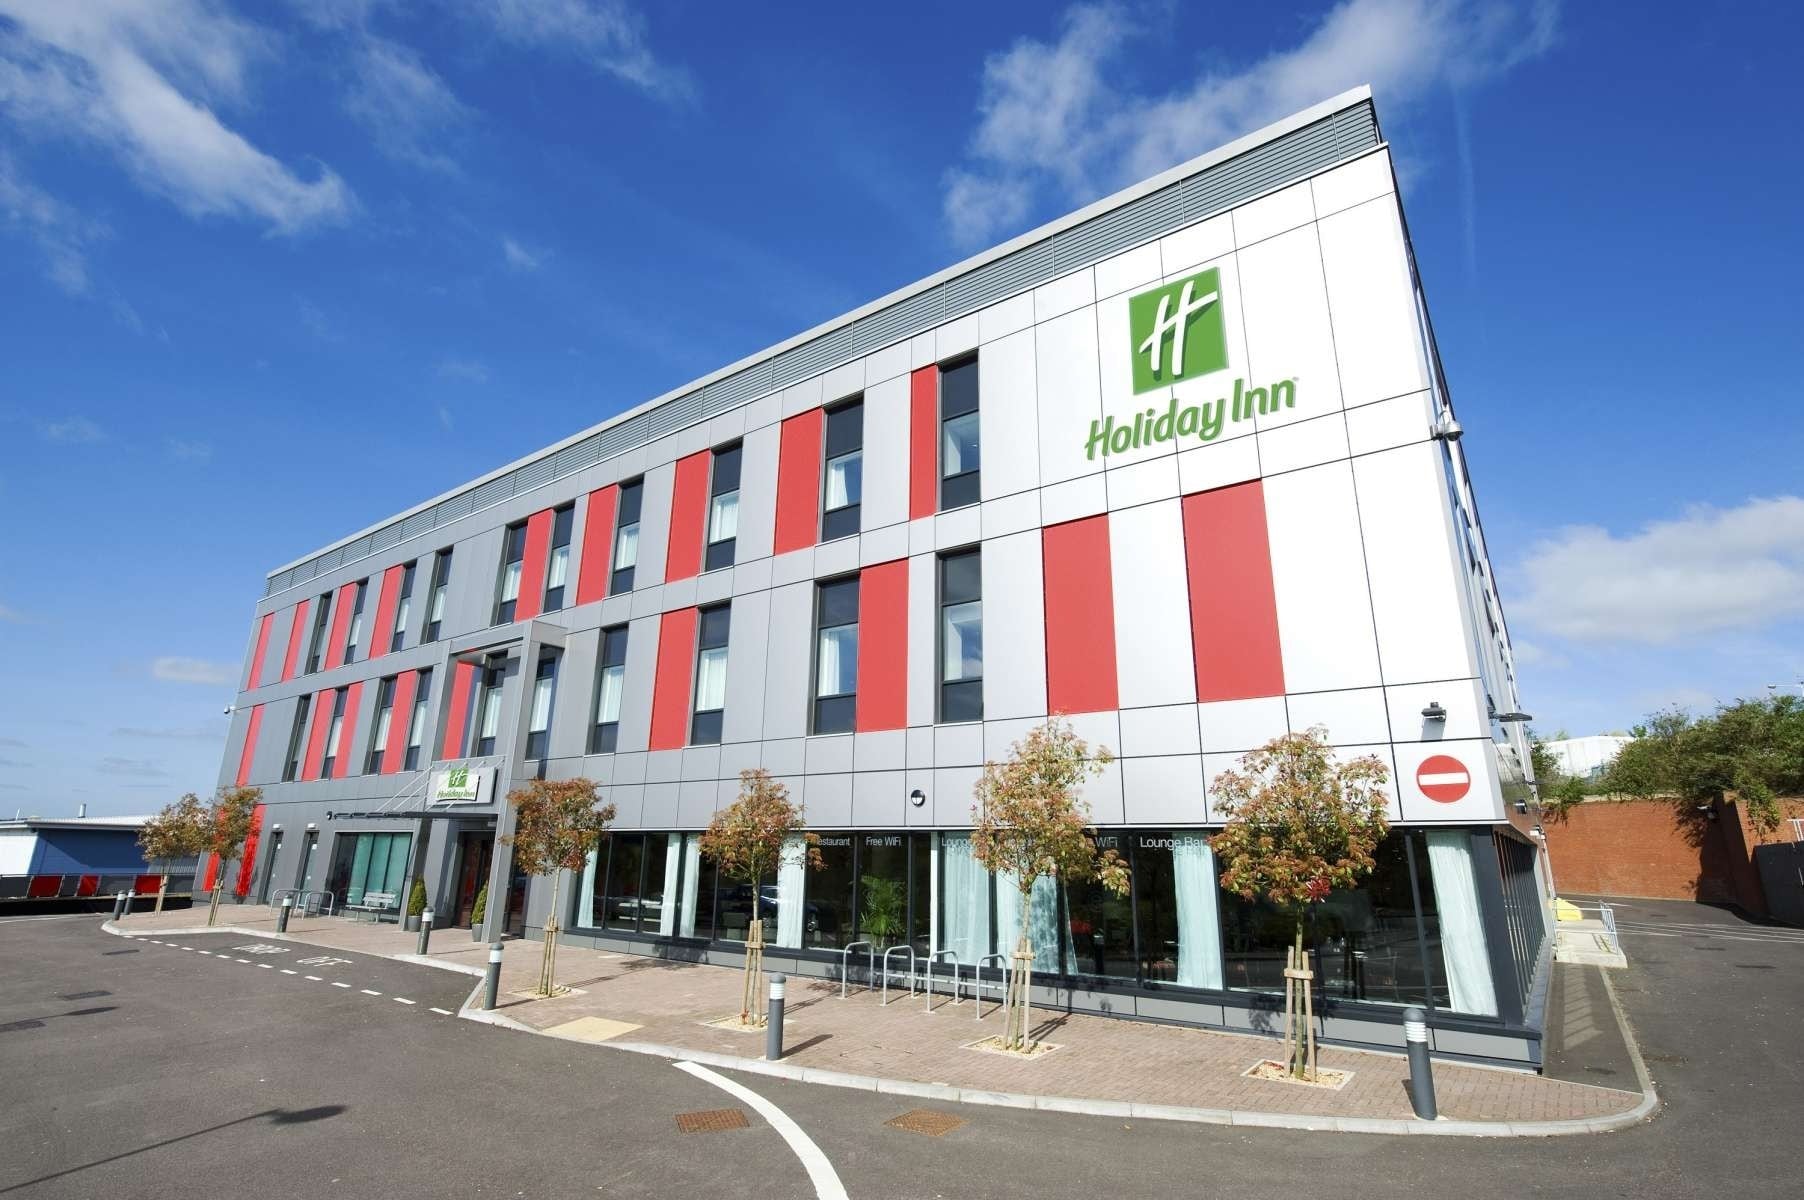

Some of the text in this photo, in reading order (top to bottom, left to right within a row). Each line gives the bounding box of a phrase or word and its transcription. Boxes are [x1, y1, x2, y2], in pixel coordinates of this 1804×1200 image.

[1085, 378, 1296, 461] Holiday Inn
[817, 837, 850, 847] estaurant
[866, 836, 883, 846] Free
[1140, 837, 1181, 850] Lounge
